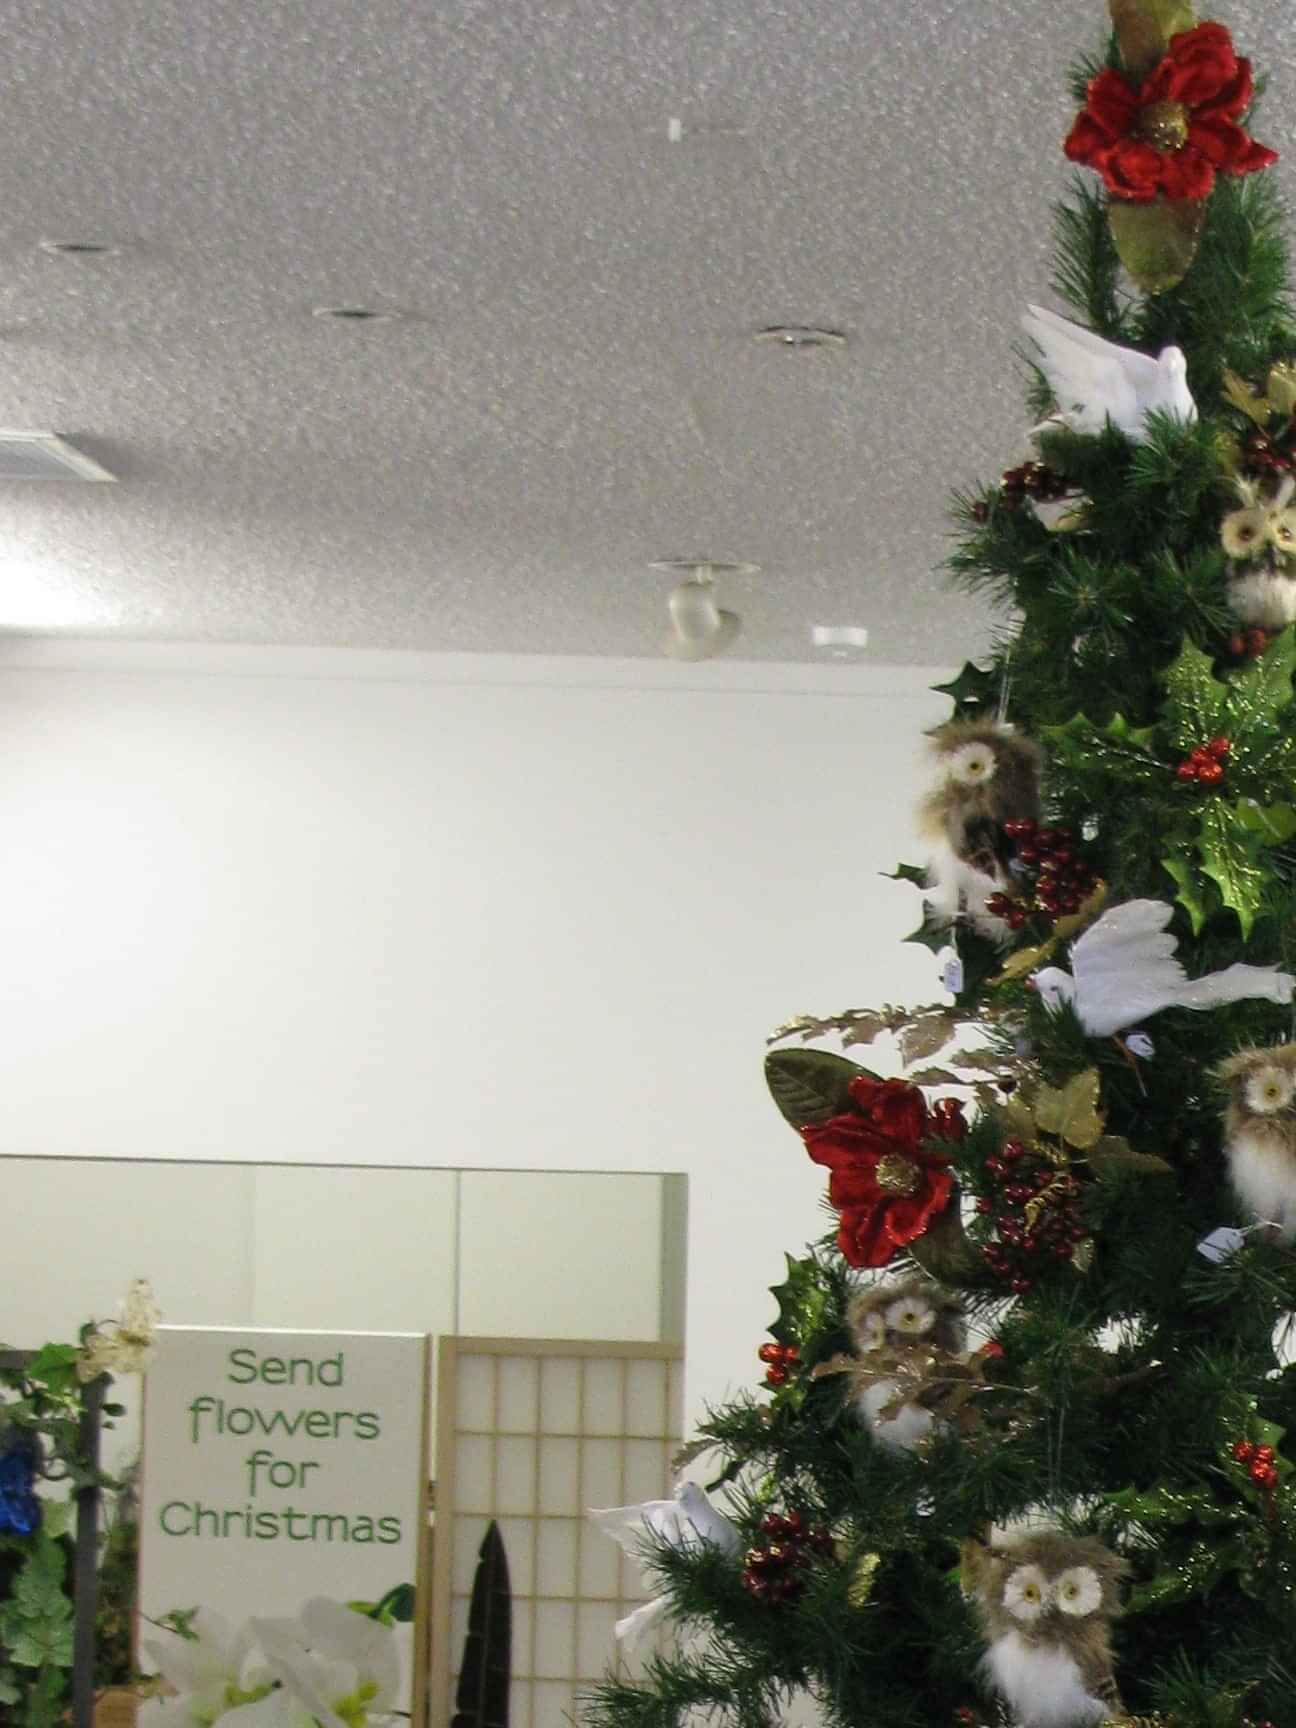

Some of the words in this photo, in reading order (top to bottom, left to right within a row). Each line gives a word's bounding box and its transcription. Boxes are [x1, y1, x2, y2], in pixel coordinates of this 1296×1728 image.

[228, 1348, 344, 1386] Send
[188, 1397, 381, 1443] flowers
[246, 1450, 320, 1497] for
[159, 1502, 402, 1544] Christmas
